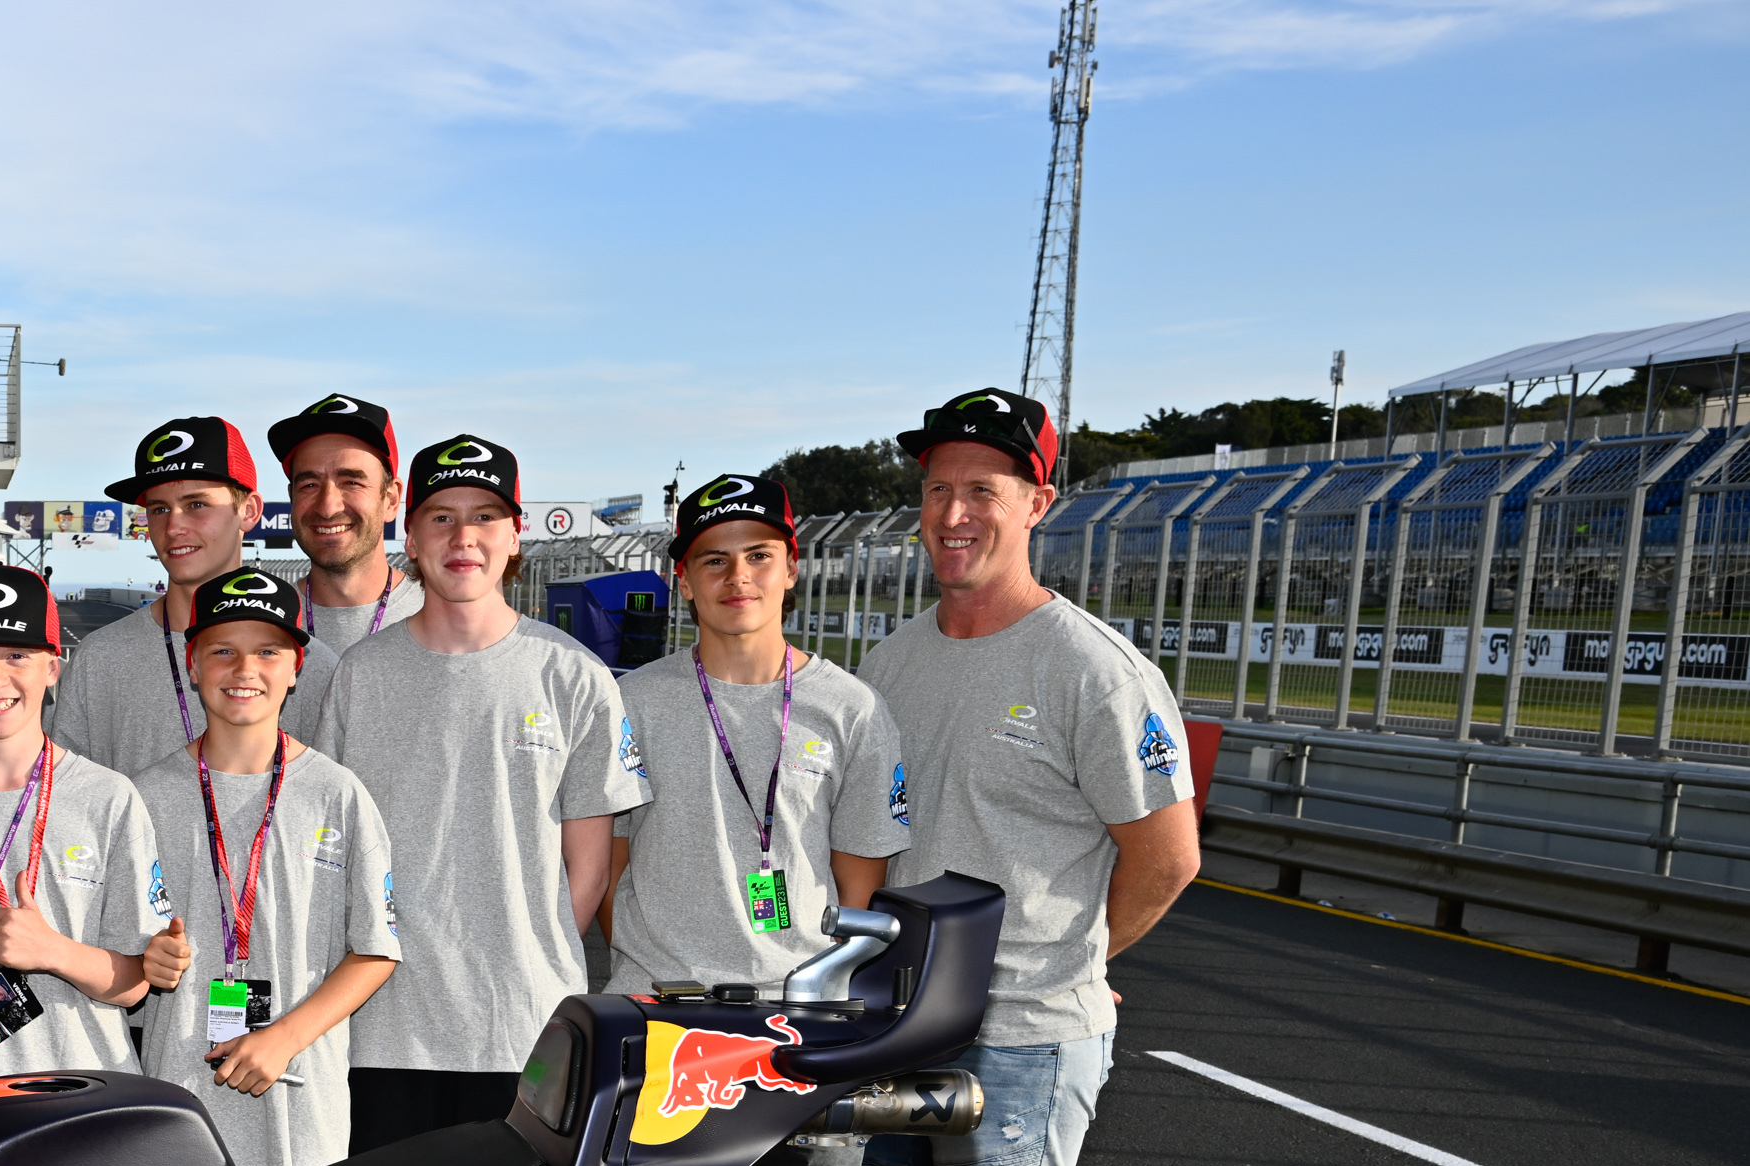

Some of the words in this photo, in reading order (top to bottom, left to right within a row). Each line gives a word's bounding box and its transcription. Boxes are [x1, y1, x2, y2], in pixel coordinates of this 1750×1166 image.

[427, 468, 501, 486] OHVALE
[260, 513, 293, 531] ME
[213, 598, 286, 619] OHVALE
[1000, 716, 1038, 732] OHVALE
[991, 733, 1035, 750] AUSTRALIA
[12, 982, 29, 1004] VENUE
